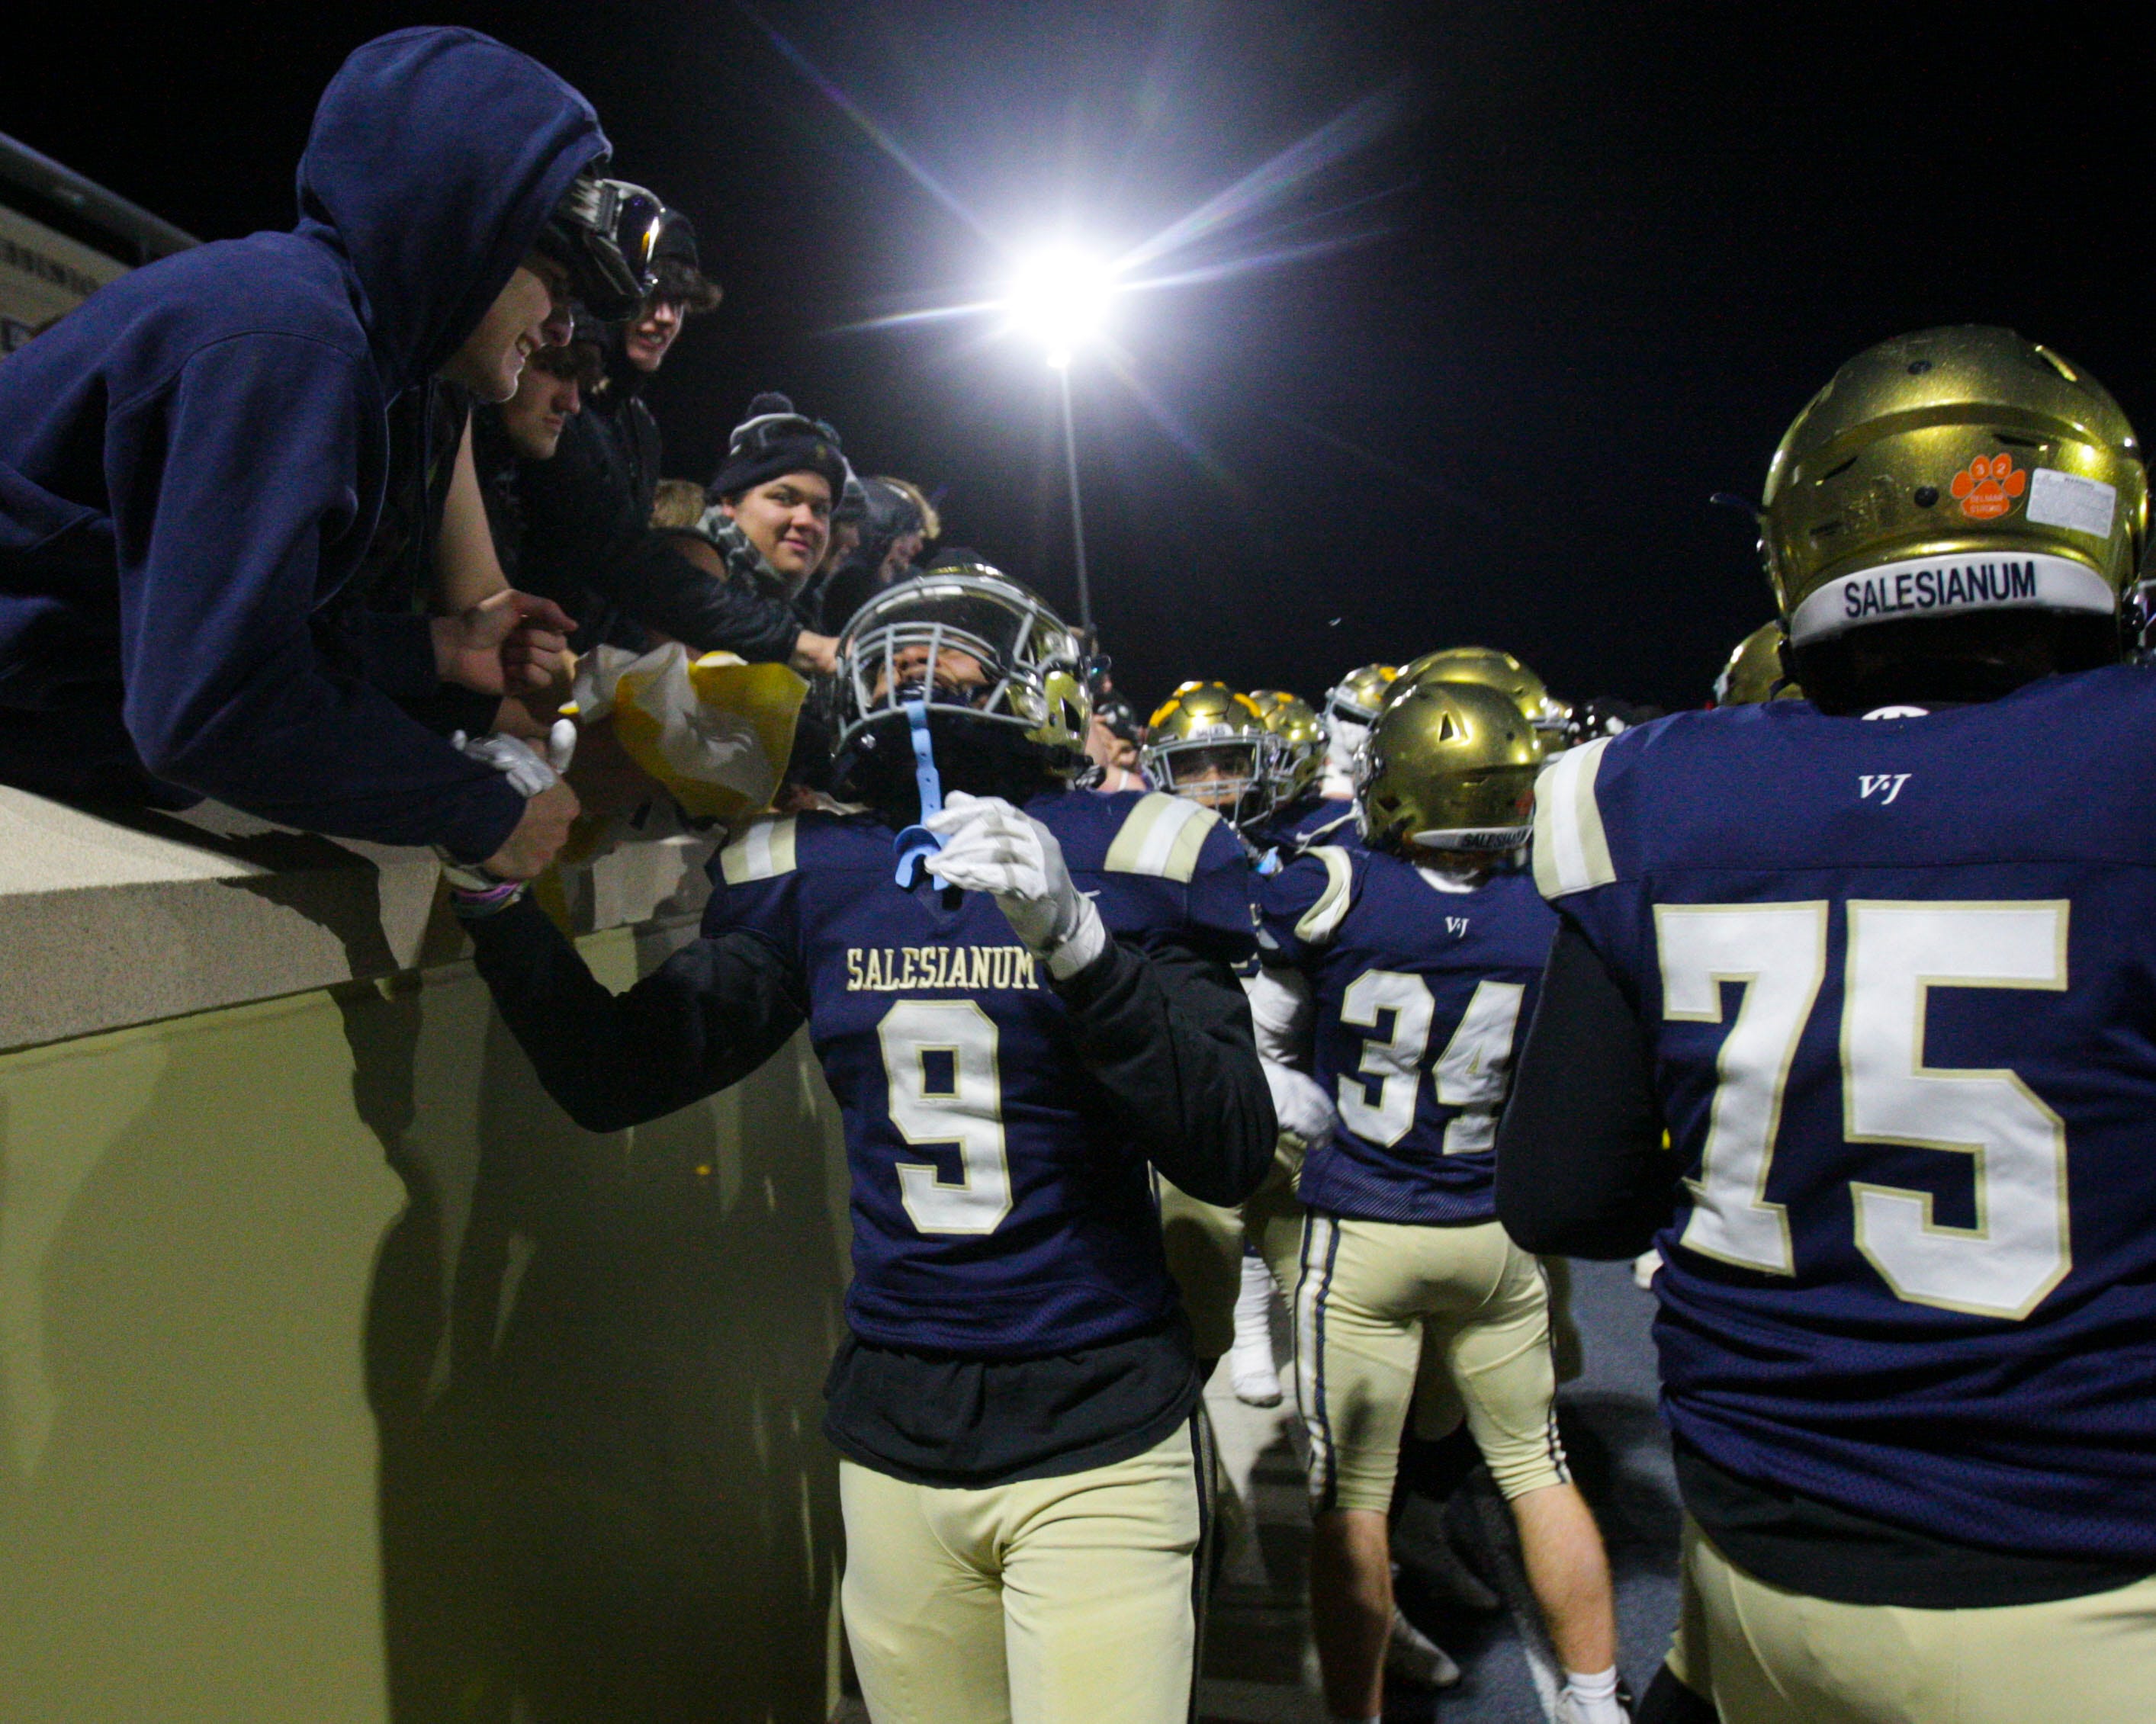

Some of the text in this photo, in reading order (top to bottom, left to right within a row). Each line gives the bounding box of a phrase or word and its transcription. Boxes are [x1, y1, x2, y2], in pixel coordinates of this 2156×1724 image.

[1844, 561, 2036, 618] SALESIANUM
[846, 946, 1039, 991] SALESIANUM
[1337, 968, 1526, 1155] 34
[876, 999, 1014, 1235] 9
[1653, 899, 2072, 1321] 75
